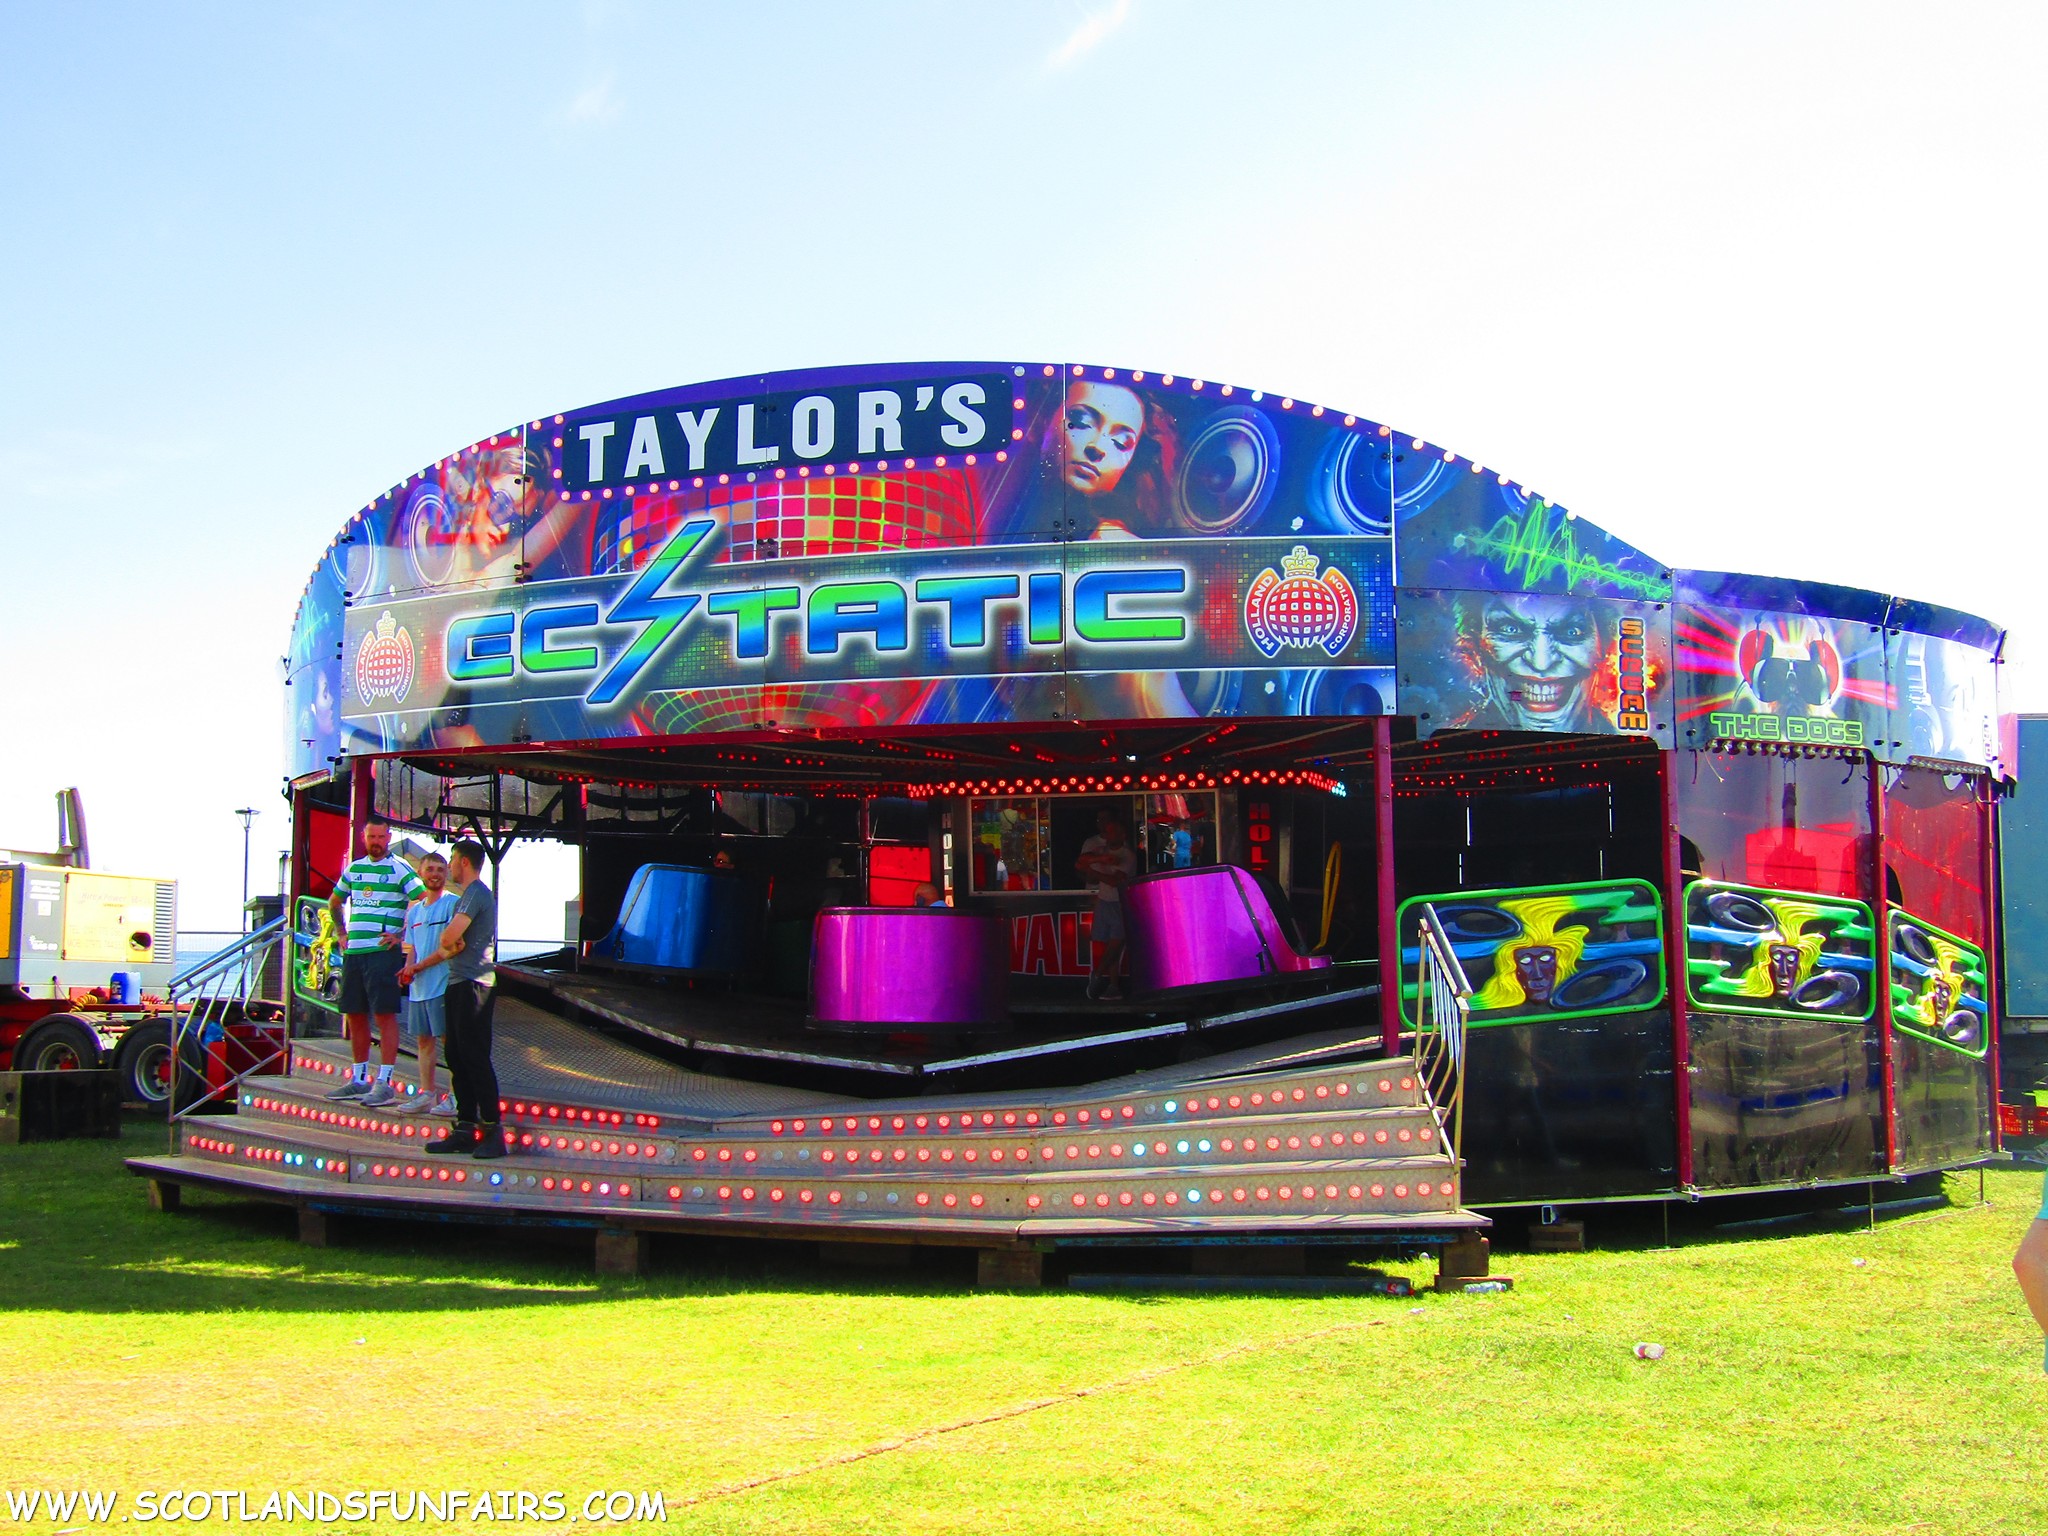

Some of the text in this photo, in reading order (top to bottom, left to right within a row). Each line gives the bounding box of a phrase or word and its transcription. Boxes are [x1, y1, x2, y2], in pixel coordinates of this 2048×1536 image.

[579, 382, 987, 483] TAYLOR'S
[446, 519, 1186, 704] ECSTATIC
[1251, 575, 1274, 651] HOLLAND
[1329, 575, 1352, 650] CORPORATION
[358, 637, 373, 700] HOLLAND
[397, 633, 412, 697] CORPORATION
[1619, 618, 1648, 730] SCREAM
[1710, 712, 1863, 745] THE DOGS
[1249, 803, 1270, 871] HOL
